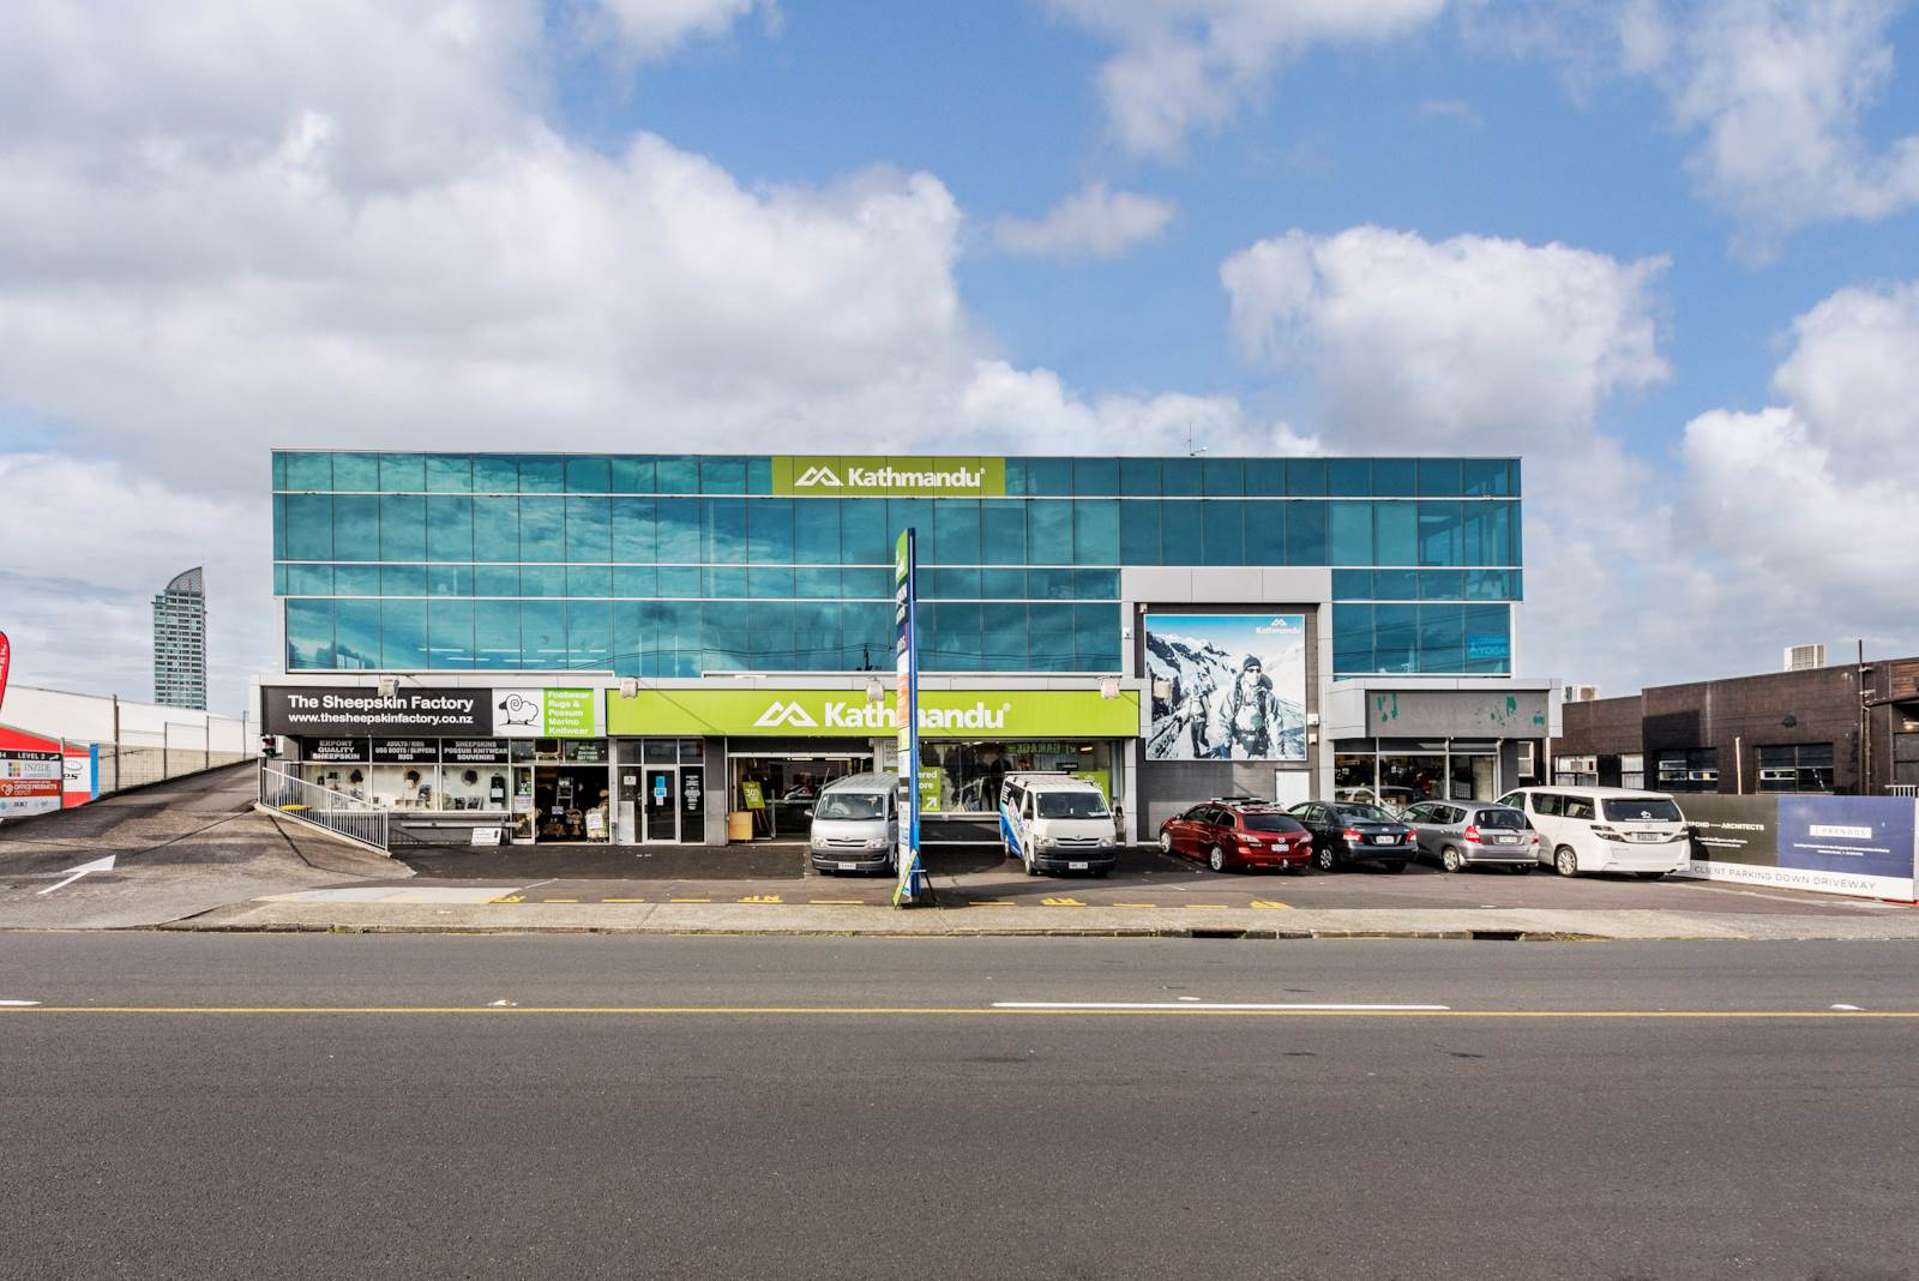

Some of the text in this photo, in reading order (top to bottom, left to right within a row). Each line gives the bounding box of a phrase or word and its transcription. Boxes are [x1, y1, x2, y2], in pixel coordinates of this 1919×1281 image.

[848, 467, 981, 488] Kathmandu
[288, 695, 474, 713] The Sheepskin Factory
[288, 713, 474, 725] www.thesheepskinfactory.co.nz
[17, 752, 39, 760] LEVEL
[1721, 822, 1765, 831] ARCHITECTS
[1694, 865, 1875, 889] CLIENT PARKING DOWN DRIVEWAY
